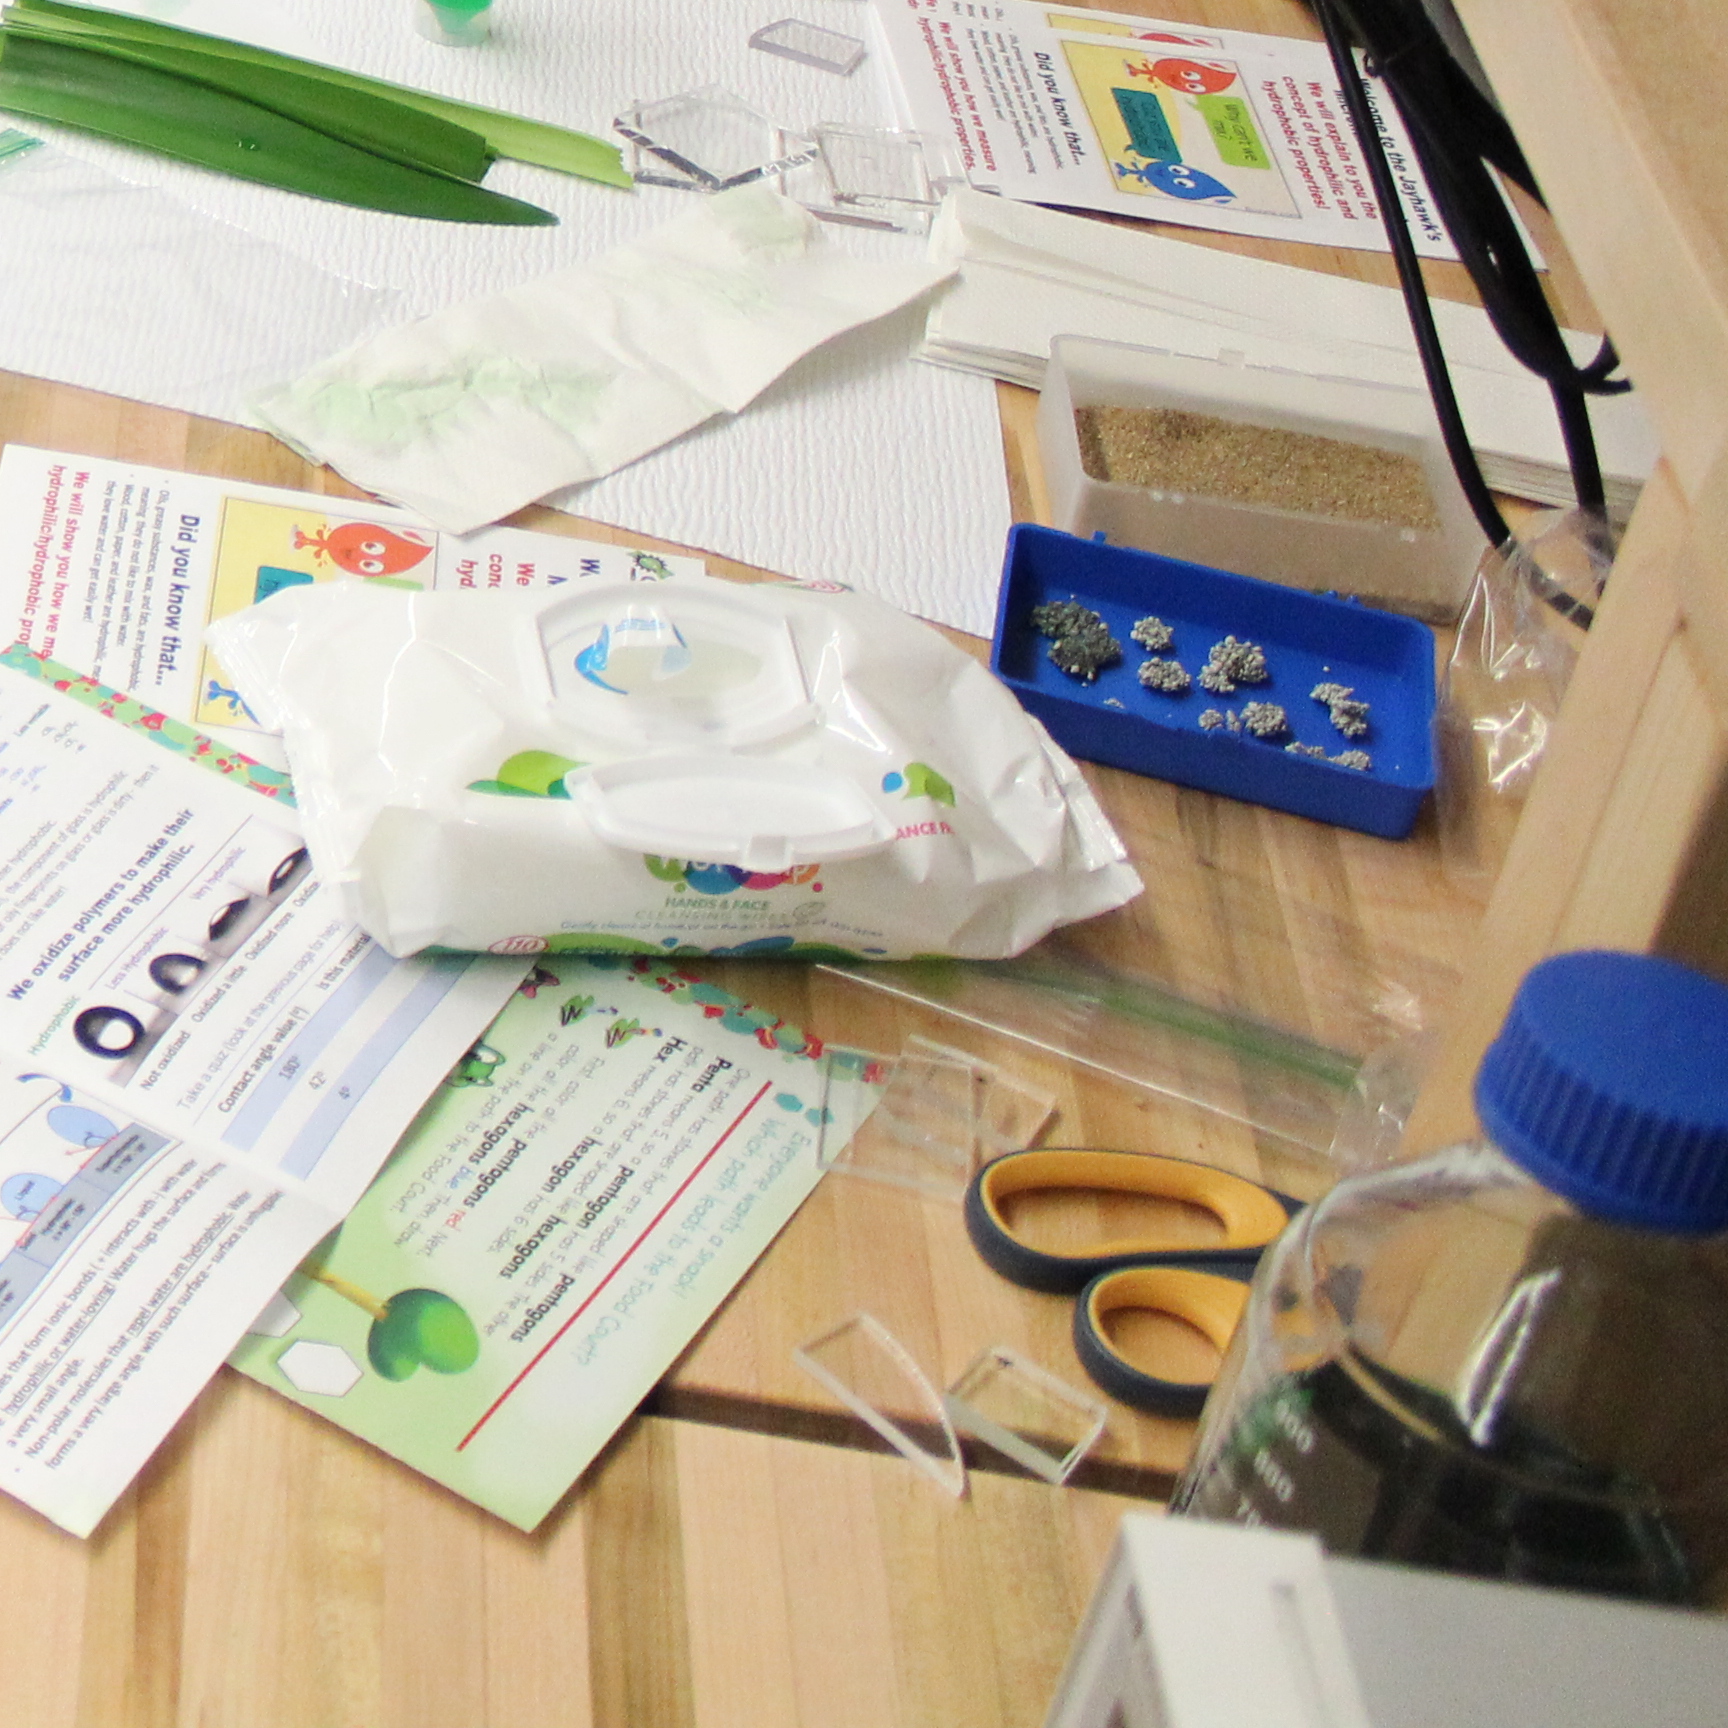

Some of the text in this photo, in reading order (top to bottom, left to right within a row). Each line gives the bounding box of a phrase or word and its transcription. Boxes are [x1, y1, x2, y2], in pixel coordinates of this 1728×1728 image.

[938, 22, 994, 170] We will show you how we measure
[1034, 53, 1085, 165] Did you know that...
[1306, 83, 1322, 96] We
[1315, 102, 1334, 118] will
[1262, 80, 1330, 210] hydrophobic properties!
[1283, 77, 1356, 218] concept of hydrophilic and
[1324, 123, 1349, 160] explain
[1343, 165, 1357, 174] to
[1346, 179, 1366, 197] you
[1360, 203, 1376, 218] the
[68, 493, 84, 517] will
[73, 471, 91, 490] We
[23, 465, 68, 615] hydrophilic/hydrophobic
[62, 518, 81, 547] show
[55, 549, 72, 578] you
[50, 582, 70, 610] how
[154, 514, 200, 685] Did you know that...
[45, 613, 59, 633] we
[7, 809, 194, 1001] We oxidize polymers to make their
[58, 844, 194, 980] surface more hydrophilic.
[467, 1100, 532, 1166] hexagons
[541, 1035, 686, 1195] Hex hexagon
[576, 1055, 731, 1230] Penta pentagon
[462, 1135, 524, 1209] pentagons
